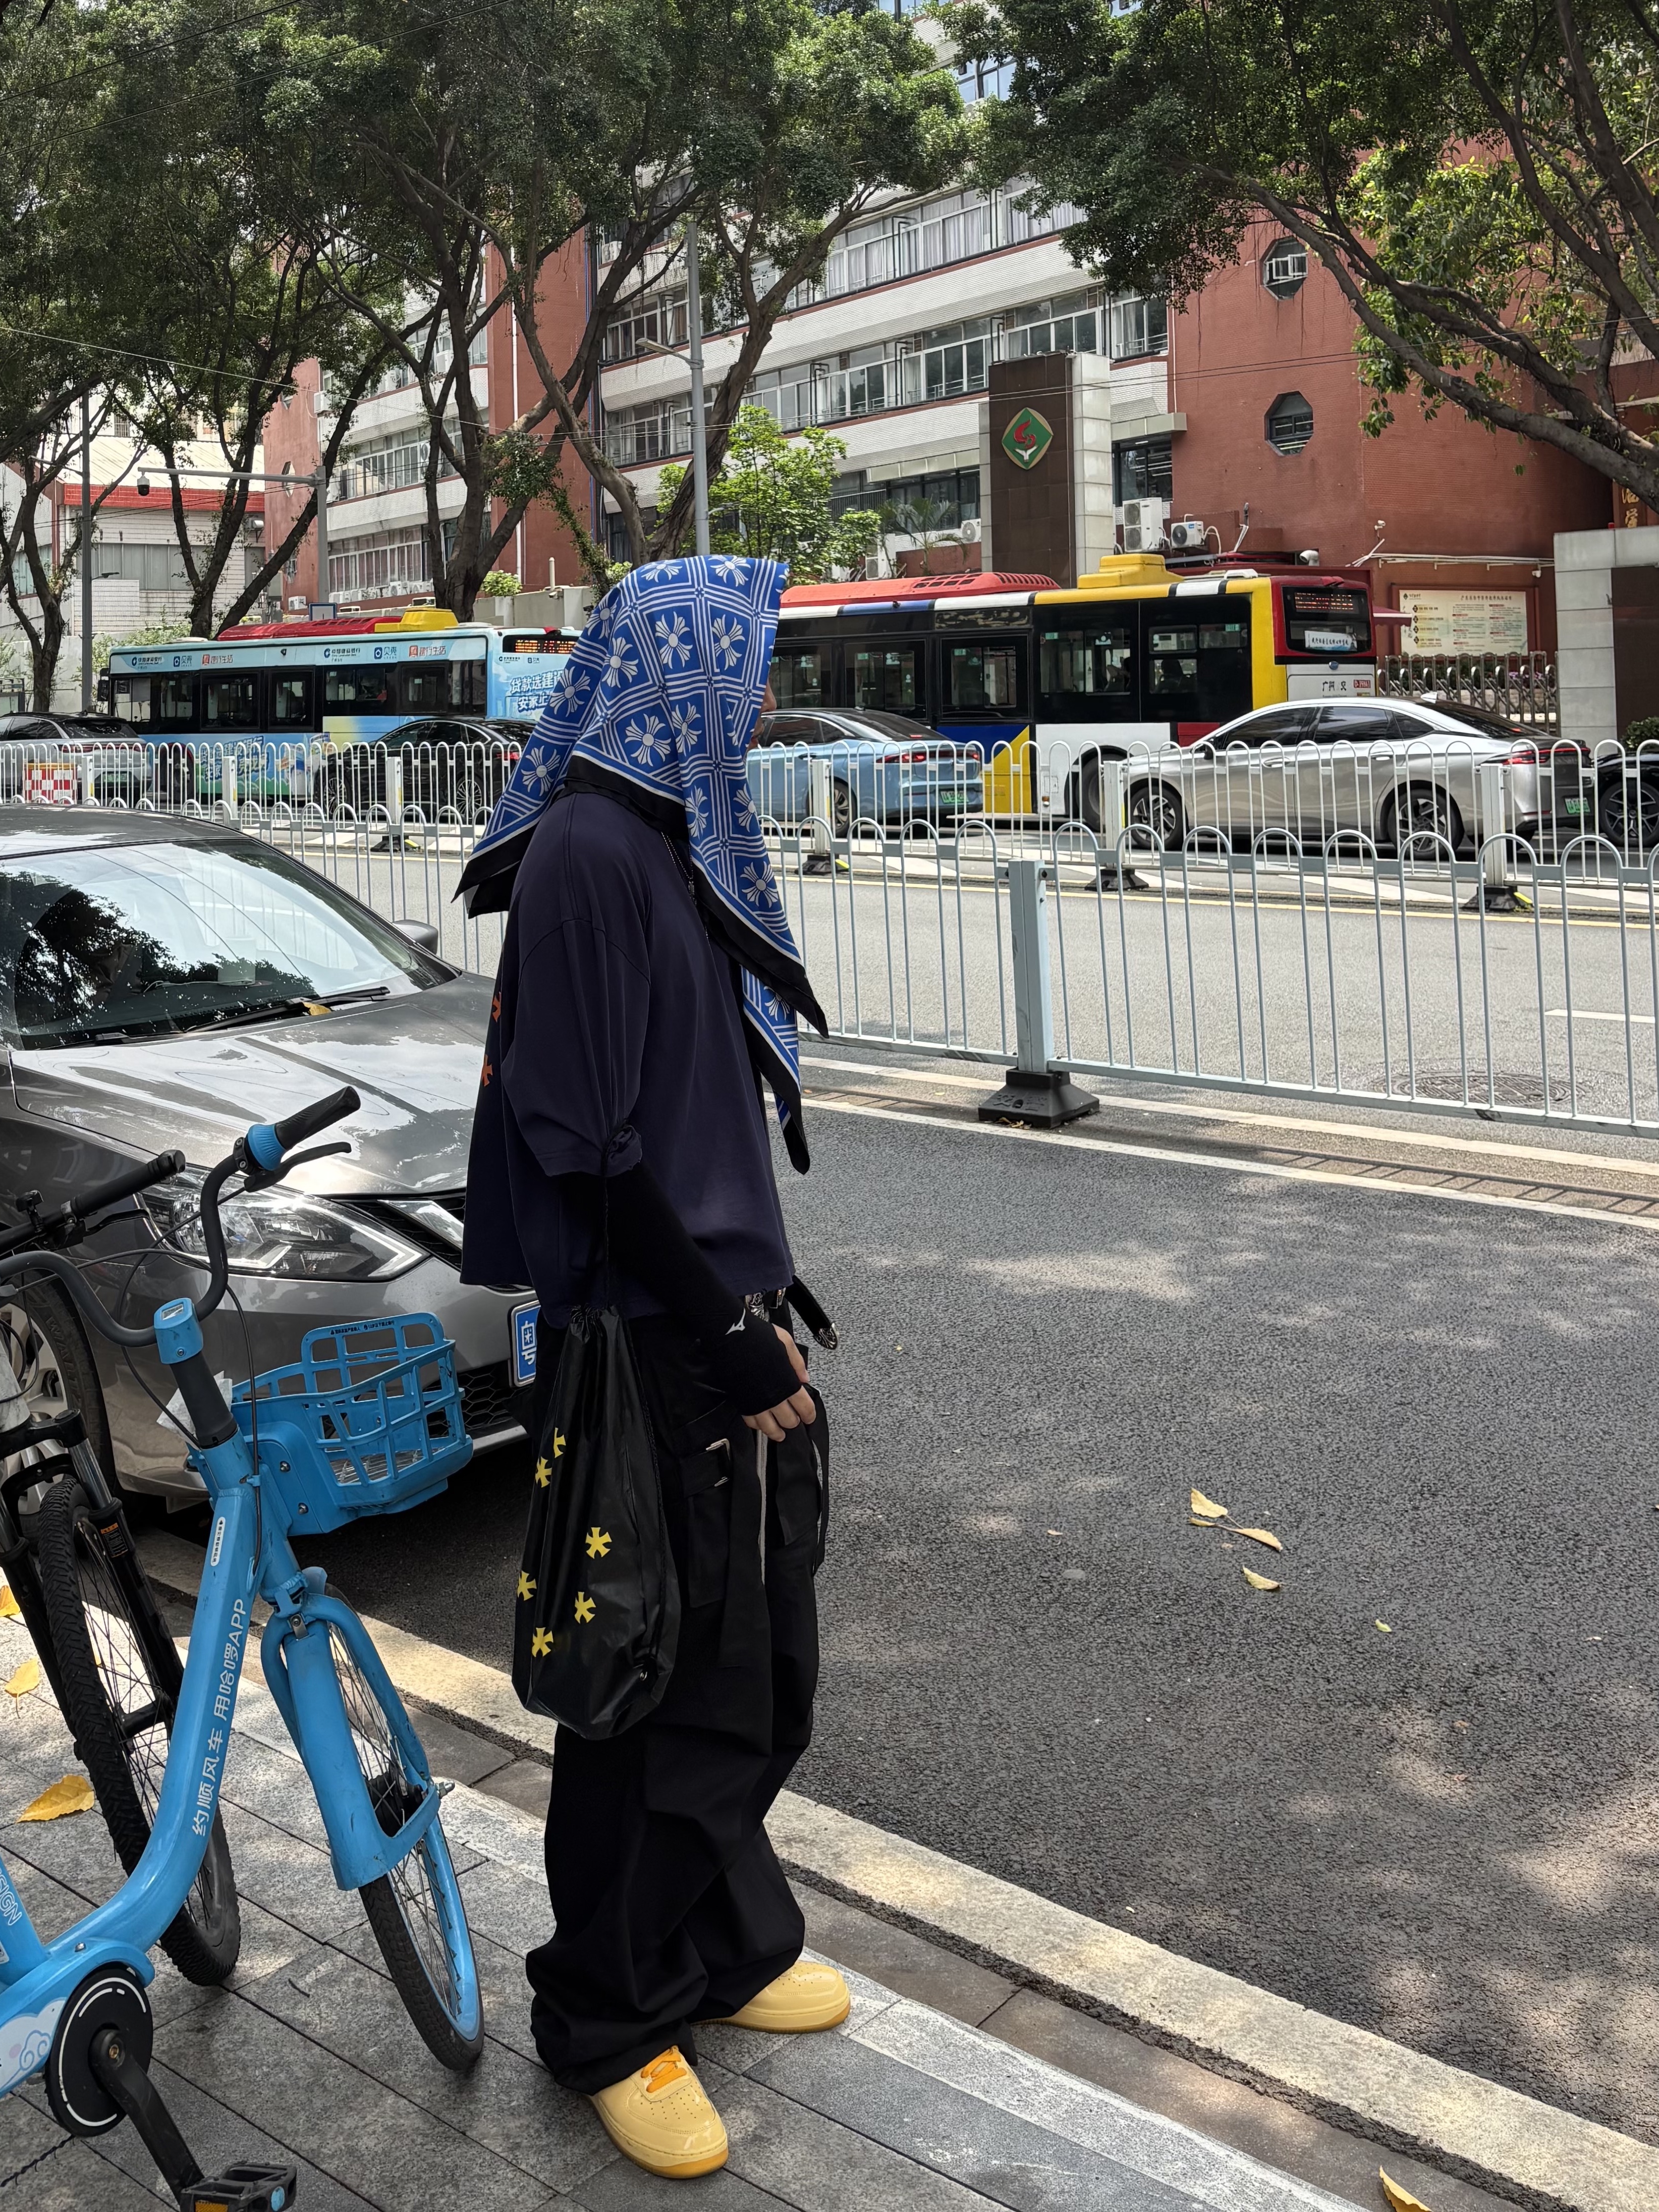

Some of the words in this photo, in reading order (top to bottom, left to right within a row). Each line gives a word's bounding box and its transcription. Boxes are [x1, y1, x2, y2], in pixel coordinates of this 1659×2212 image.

[1322, 681, 1347, 691] 广州交
[521, 1320, 537, 1365] 粤
[192, 1728, 223, 1837] 约顺风车
[213, 1598, 246, 1721] 用哈啰APP
[0, 1868, 22, 1926] SIGN
